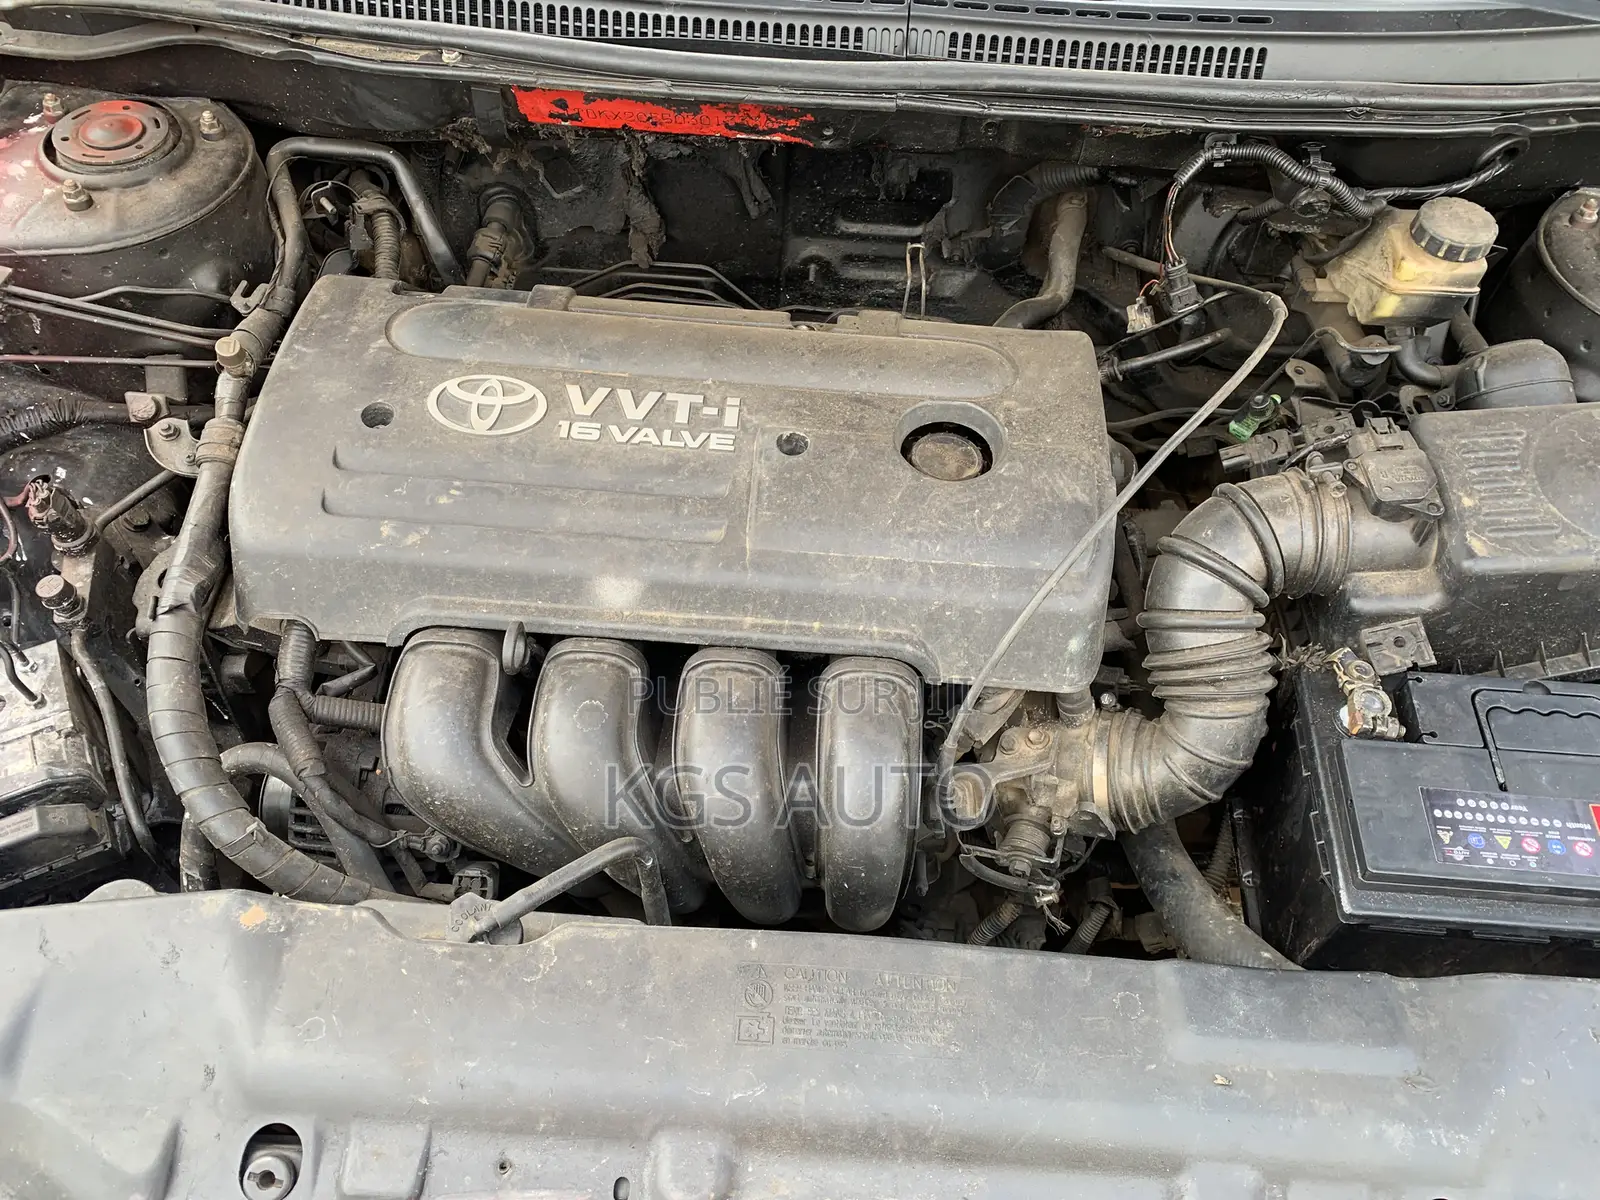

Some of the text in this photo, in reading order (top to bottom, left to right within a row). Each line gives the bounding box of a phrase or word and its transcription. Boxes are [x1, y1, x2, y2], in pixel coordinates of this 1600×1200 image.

[565, 384, 741, 428] VVT-i
[557, 420, 736, 451] 16 VALVE
[783, 967, 848, 983] CAUTION
